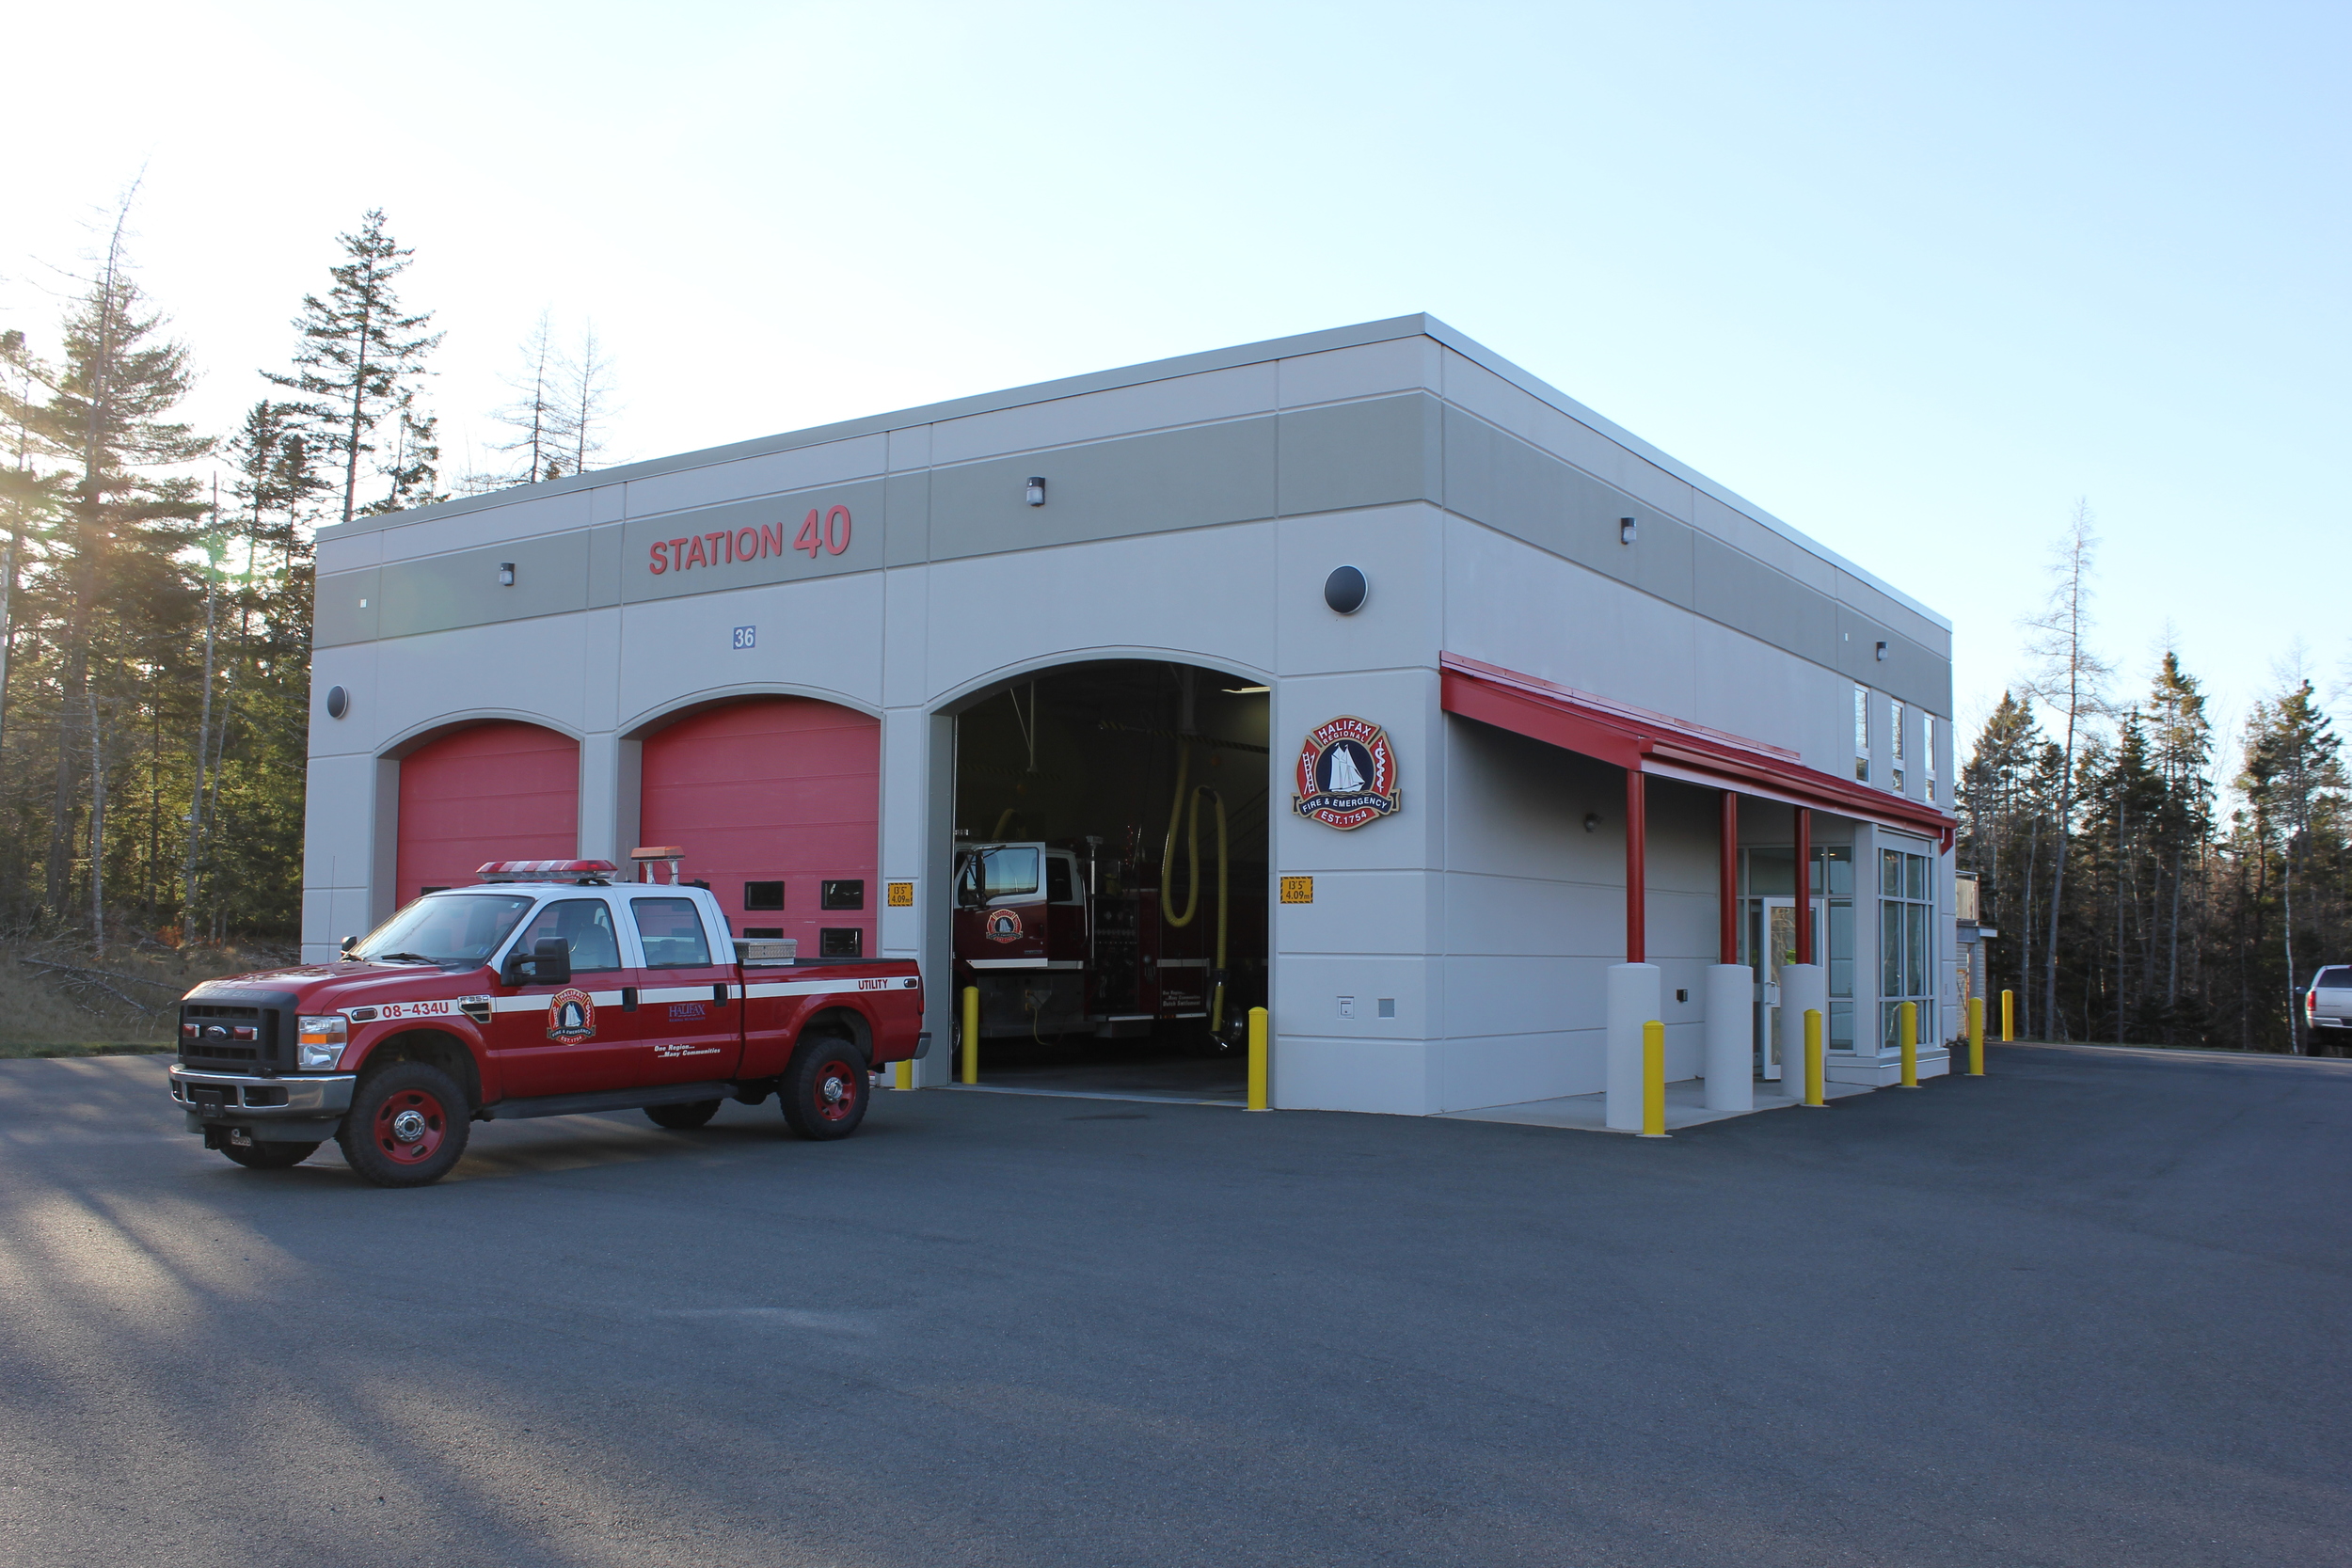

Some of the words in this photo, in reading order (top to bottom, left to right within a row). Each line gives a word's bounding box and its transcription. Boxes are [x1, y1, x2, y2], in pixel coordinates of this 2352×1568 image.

[649, 522, 783, 576] STATION
[792, 504, 851, 559] 40
[735, 627, 755, 648] 36
[1318, 720, 1372, 739] HALIFAX
[1322, 731, 1365, 745] REGIONAL
[1302, 798, 1322, 813] FIRE
[1332, 797, 1388, 809] EMERGENCY
[858, 978, 888, 990] UTILITY
[559, 990, 584, 1000] HALIFAX
[382, 1002, 450, 1019] 08-434U
[668, 1003, 706, 1018] HALIFAX
[682, 1047, 721, 1056] Communities
